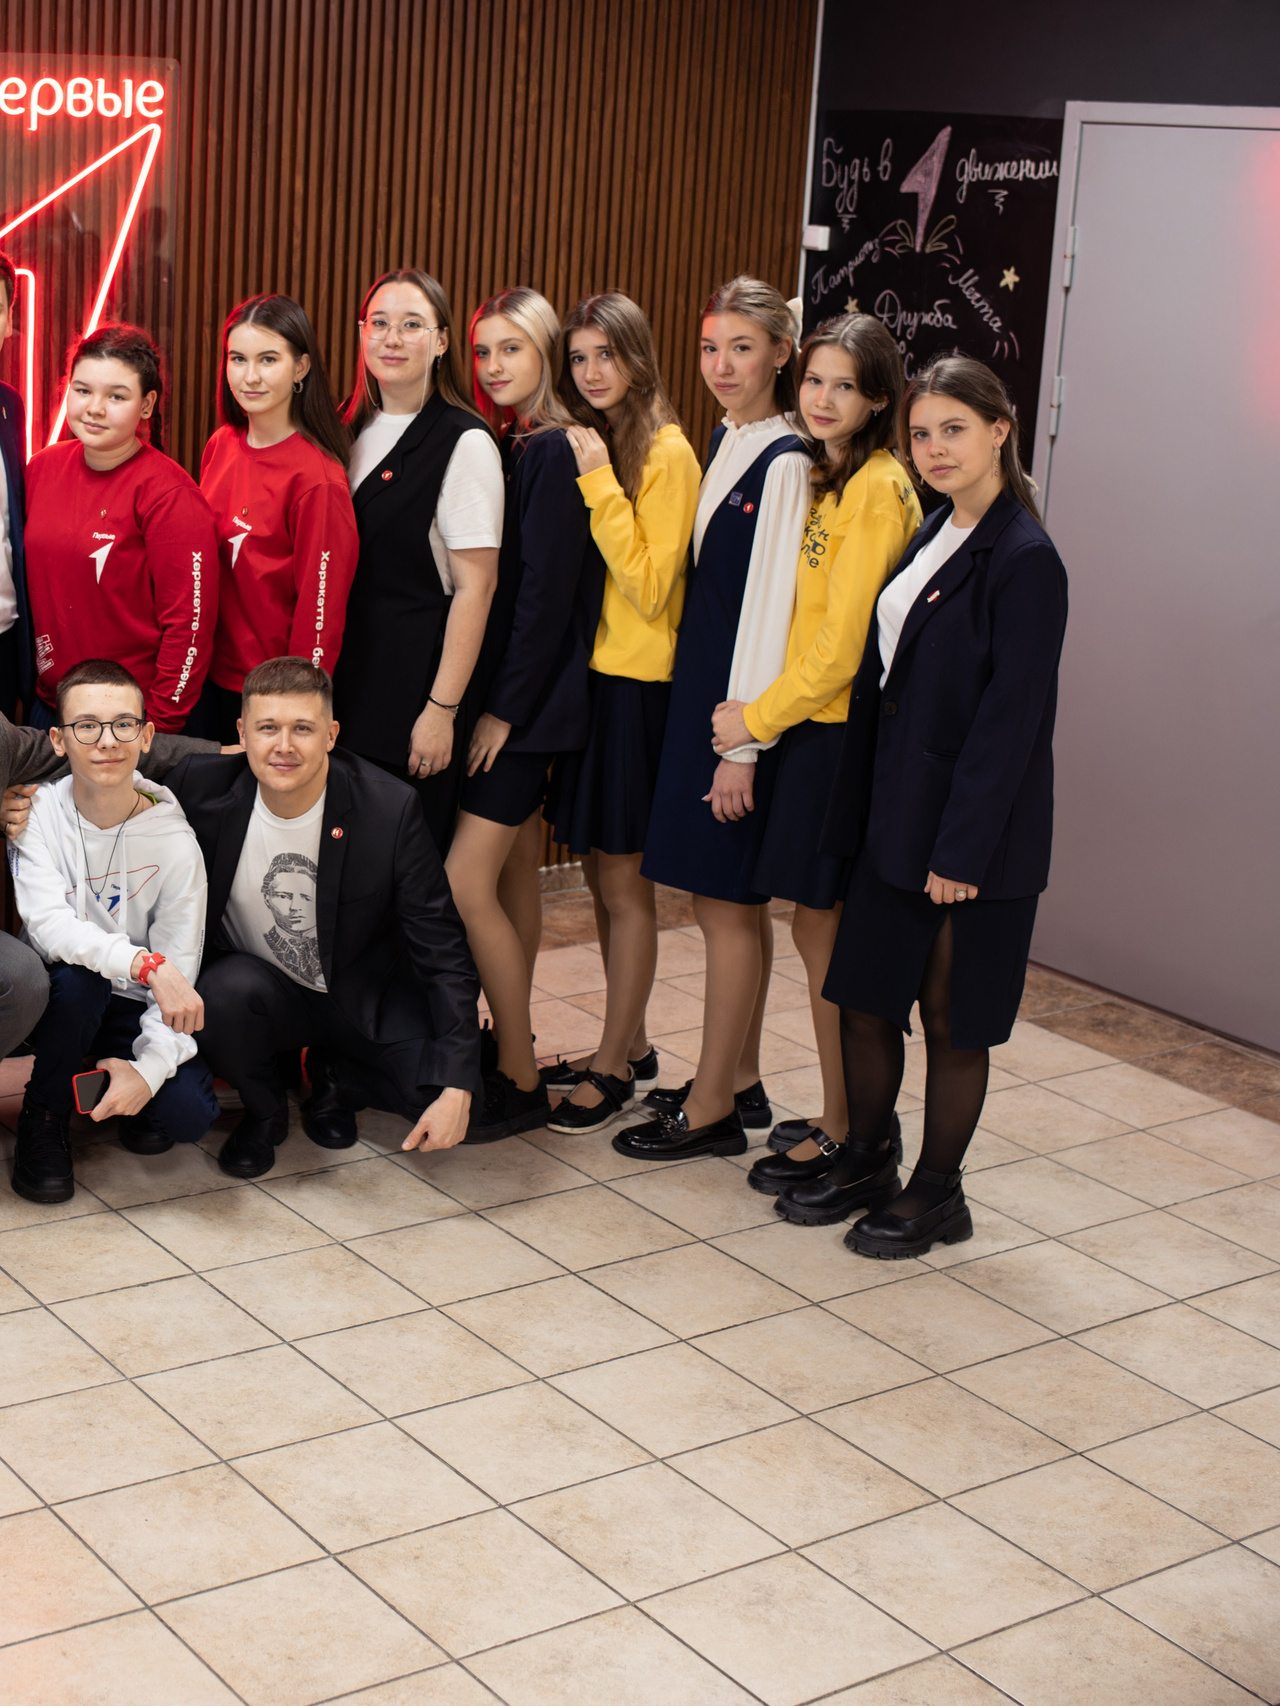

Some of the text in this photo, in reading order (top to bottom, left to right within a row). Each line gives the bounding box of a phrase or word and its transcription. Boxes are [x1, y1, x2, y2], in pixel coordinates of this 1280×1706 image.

[821, 137, 1060, 214] Будь в движении
[874, 289, 958, 339] Дружба
[948, 268, 1003, 333] Мечта
